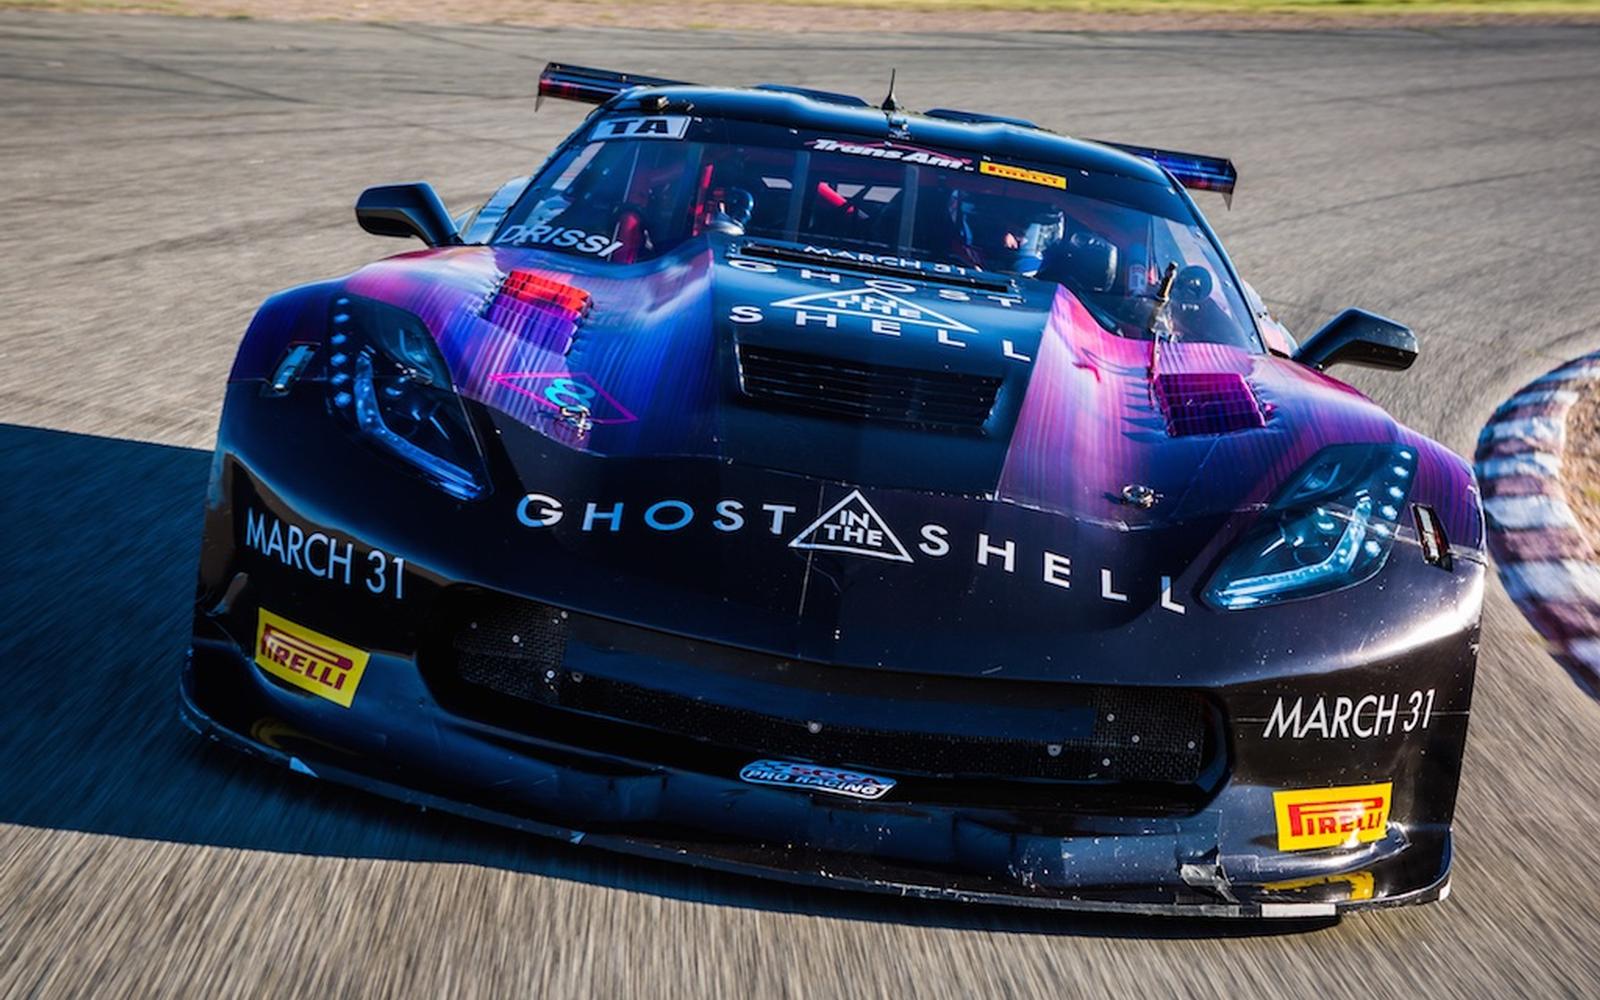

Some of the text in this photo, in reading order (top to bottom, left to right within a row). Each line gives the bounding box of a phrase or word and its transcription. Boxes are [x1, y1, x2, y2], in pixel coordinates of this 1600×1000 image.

[607, 119, 669, 135] TA
[813, 138, 904, 159] Trans
[494, 224, 624, 257] DRISSI
[804, 245, 967, 275] MARCH 31
[728, 259, 1023, 308] GHOST
[828, 297, 922, 320] THE
[850, 294, 897, 308] IN
[729, 305, 1032, 362] SHELL
[515, 492, 797, 536] GHOST
[839, 509, 870, 530] IN
[823, 522, 884, 548] THE
[246, 506, 406, 600] MARCH 31
[918, 523, 1187, 615] SHELL
[260, 622, 355, 691] PIRELLI
[1262, 687, 1436, 739] MARCH 31
[746, 769, 878, 795] PRO RACING
[1287, 796, 1384, 838] PIRELLI
